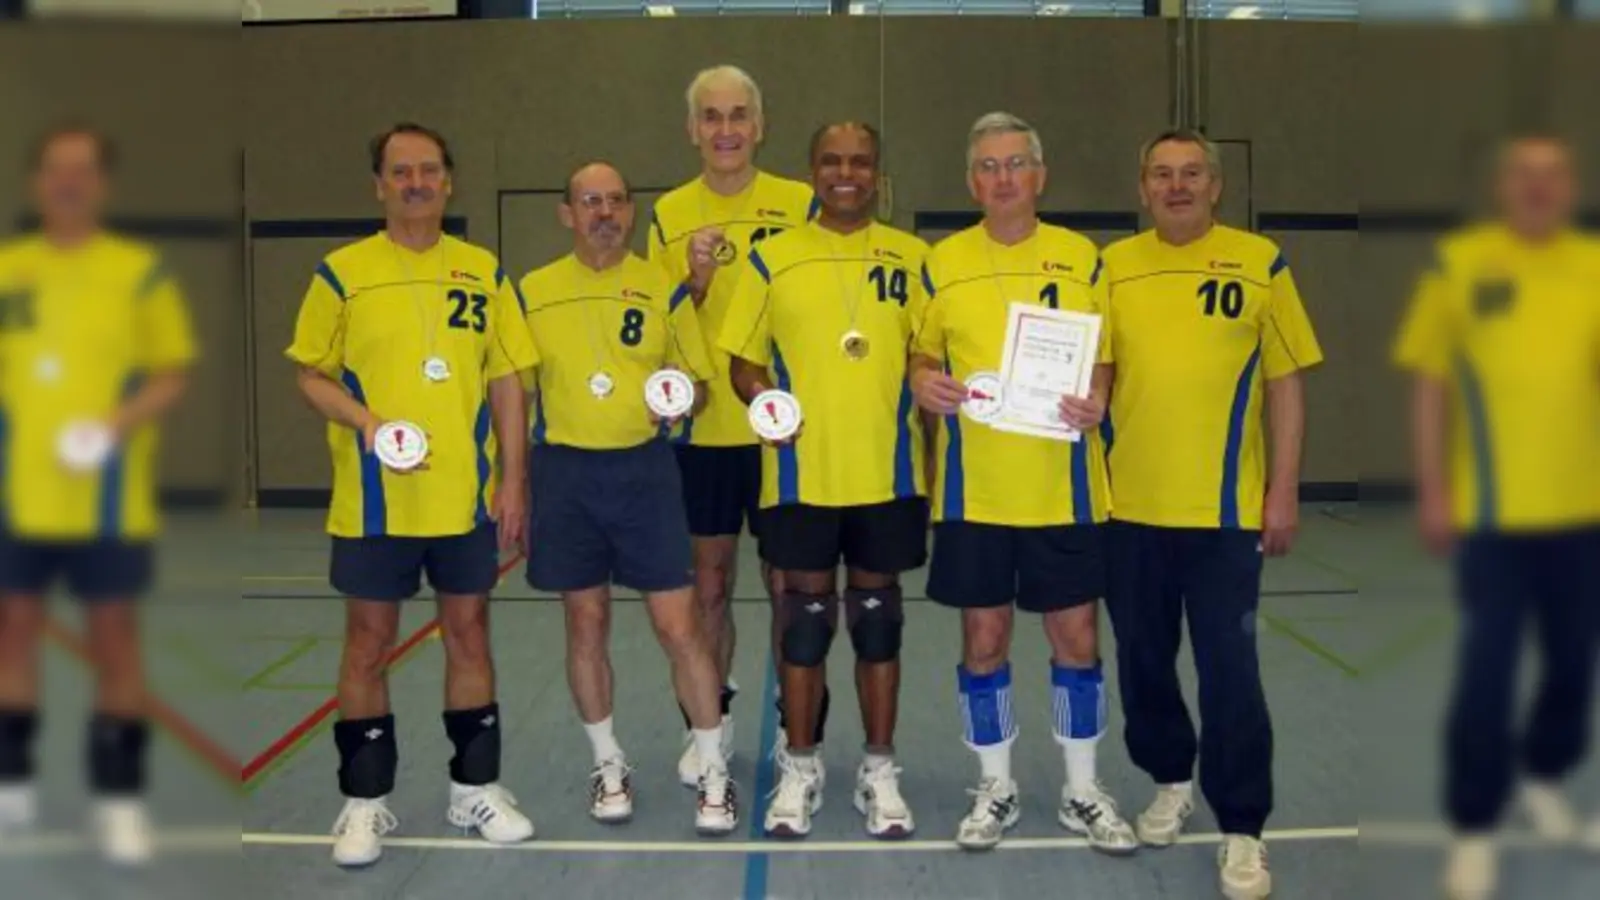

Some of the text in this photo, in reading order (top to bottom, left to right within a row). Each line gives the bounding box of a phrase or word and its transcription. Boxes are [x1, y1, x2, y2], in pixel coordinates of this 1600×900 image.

[868, 265, 908, 308] 14
[1197, 279, 1244, 320] 10
[447, 288, 487, 334] 23
[620, 308, 644, 347] 8
